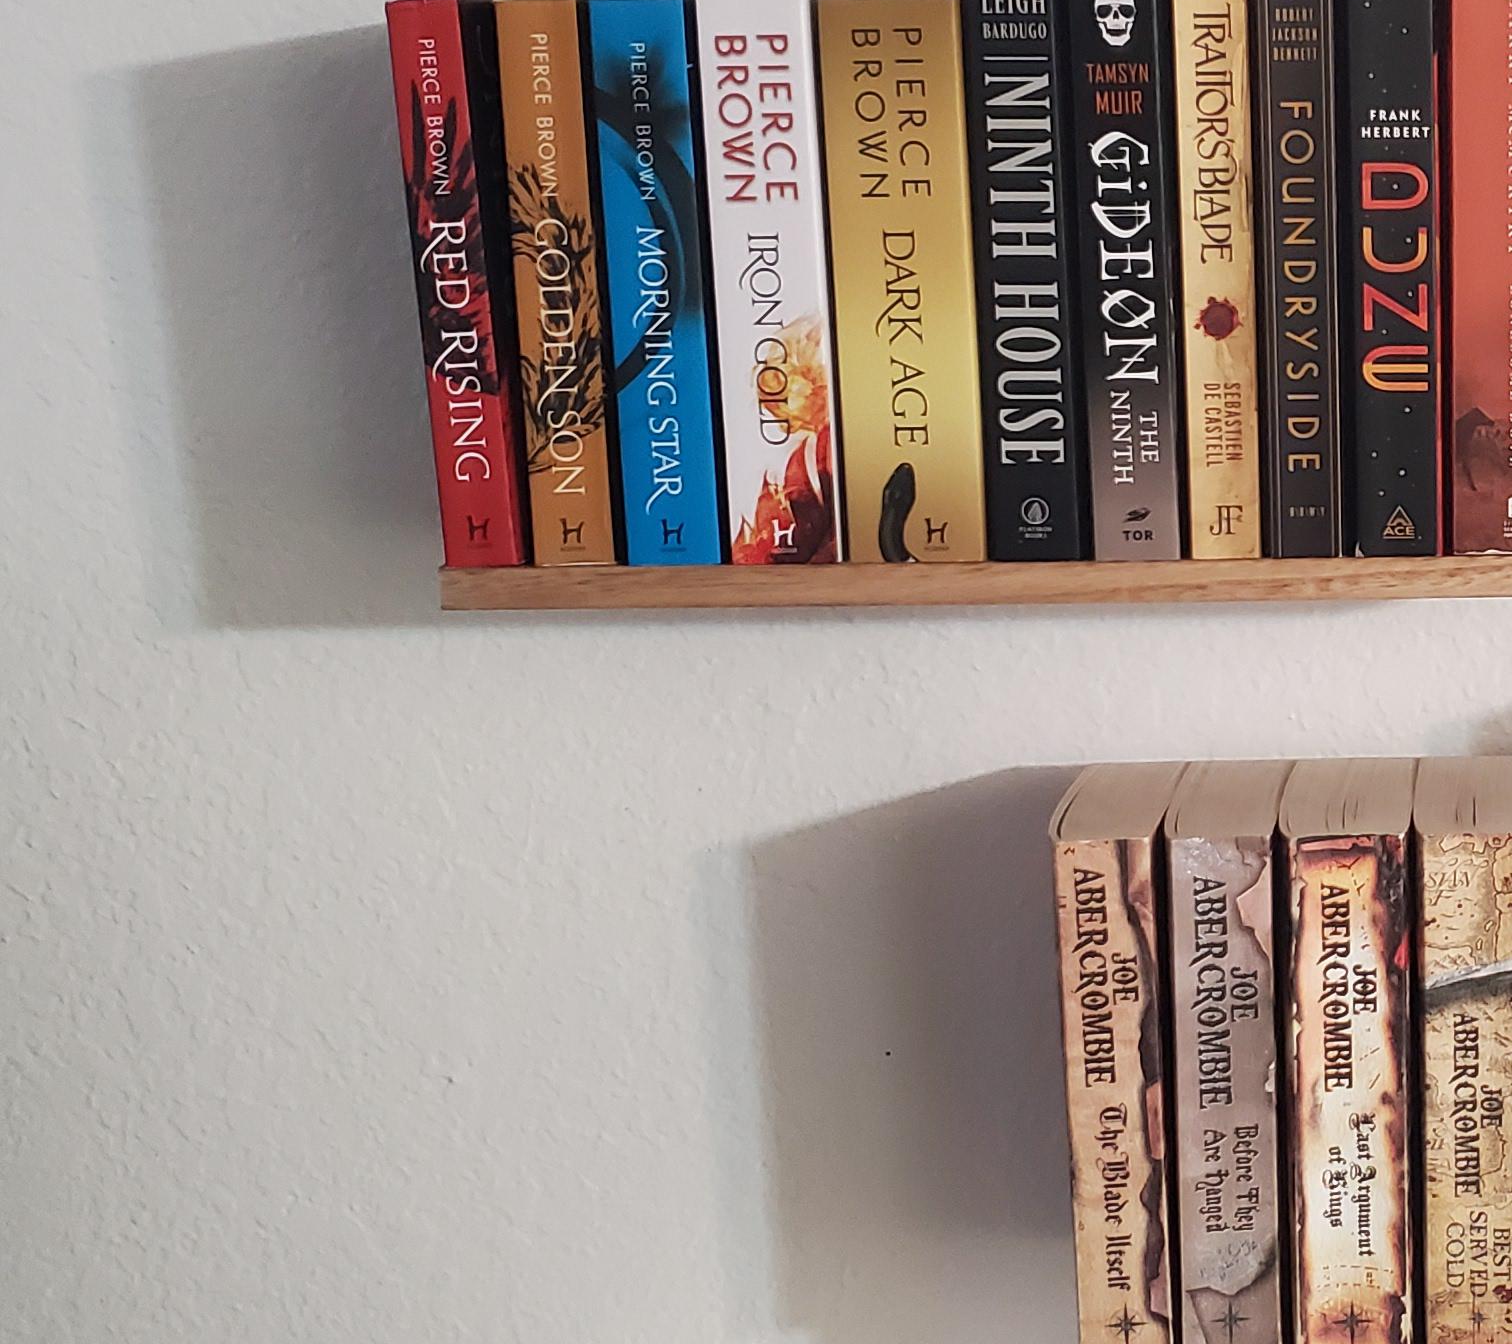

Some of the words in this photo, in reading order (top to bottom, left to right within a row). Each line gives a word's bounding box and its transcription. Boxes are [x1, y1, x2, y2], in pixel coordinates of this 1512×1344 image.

[418, 38, 441, 105] PIERCE
[982, 22, 1048, 40] BARDUGO
[1086, 64, 1149, 84] TAMSYN
[1096, 91, 1142, 115] MUIR
[1370, 109, 1421, 122] FRANK
[426, 116, 450, 196] BROWN
[714, 35, 758, 202] BROWN
[756, 34, 799, 202] PIERCE
[1361, 126, 1430, 138] HERBERT
[984, 72, 1057, 259] NINTH
[1193, 167, 1238, 265] BLADE
[420, 218, 470, 309] RED
[738, 232, 784, 329] IRON
[875, 228, 924, 344] DARK
[1279, 101, 1321, 472] FOUNDRYSIDE
[533, 218, 579, 416] GOLDEN
[632, 224, 677, 406] MORNING
[432, 328, 490, 483] RISING
[754, 337, 790, 446] GOLD
[890, 356, 930, 447] AGE
[994, 280, 1065, 464] HOUSE
[1204, 383, 1221, 400] DE
[548, 410, 586, 495] SON
[1110, 390, 1134, 485] NINTH
[1139, 412, 1160, 463] THE
[1205, 408, 1224, 467] CASTELL
[1224, 382, 1244, 461] SEBASTIEN
[645, 416, 682, 516] STAR
[1122, 530, 1154, 541] TOR
[1382, 527, 1415, 536] ACE
[1189, 875, 1233, 1110] ABERCROMBIE
[1230, 966, 1259, 1023] JOE
[1233, 1123, 1259, 1182] Before
[1232, 1186, 1260, 1232] They
[1445, 1222, 1465, 1288] COLD
[1469, 1210, 1488, 1298] SERVED
[1492, 1228, 1512, 1281] BEST
